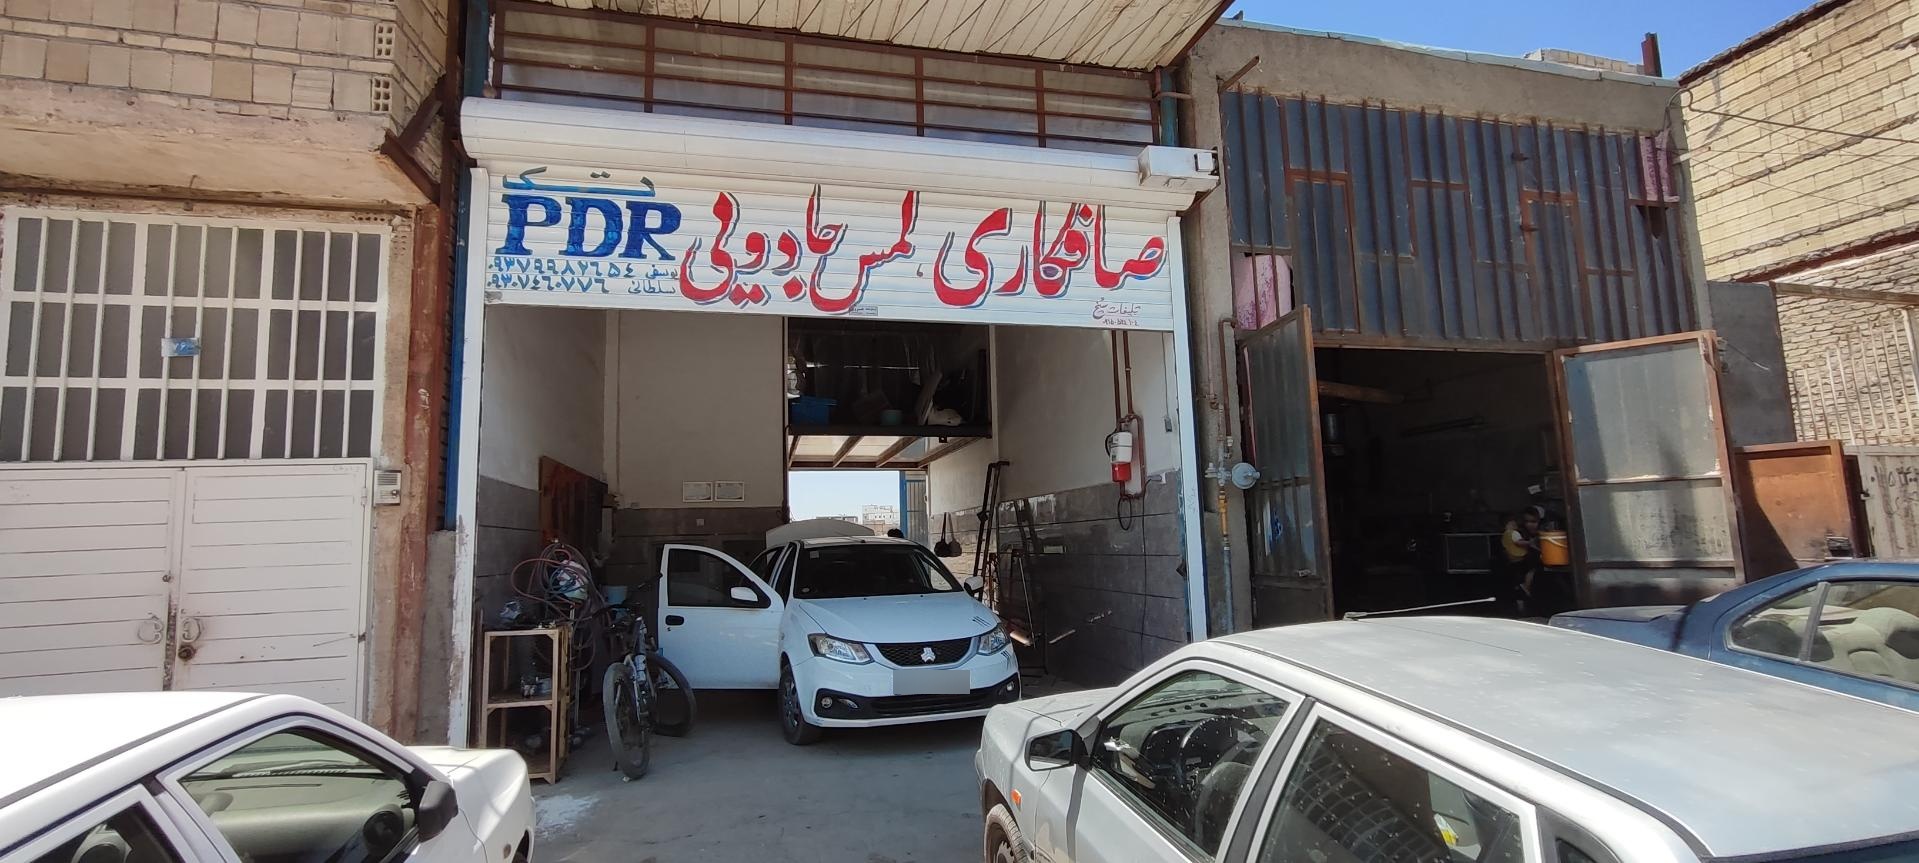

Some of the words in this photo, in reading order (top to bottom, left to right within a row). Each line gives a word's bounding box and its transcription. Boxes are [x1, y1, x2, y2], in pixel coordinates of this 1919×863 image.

[495, 193, 682, 261] PDR
[809, 190, 921, 315] لمس
[933, 200, 1169, 309] صافکاری
[627, 279, 676, 294] سلطانی
